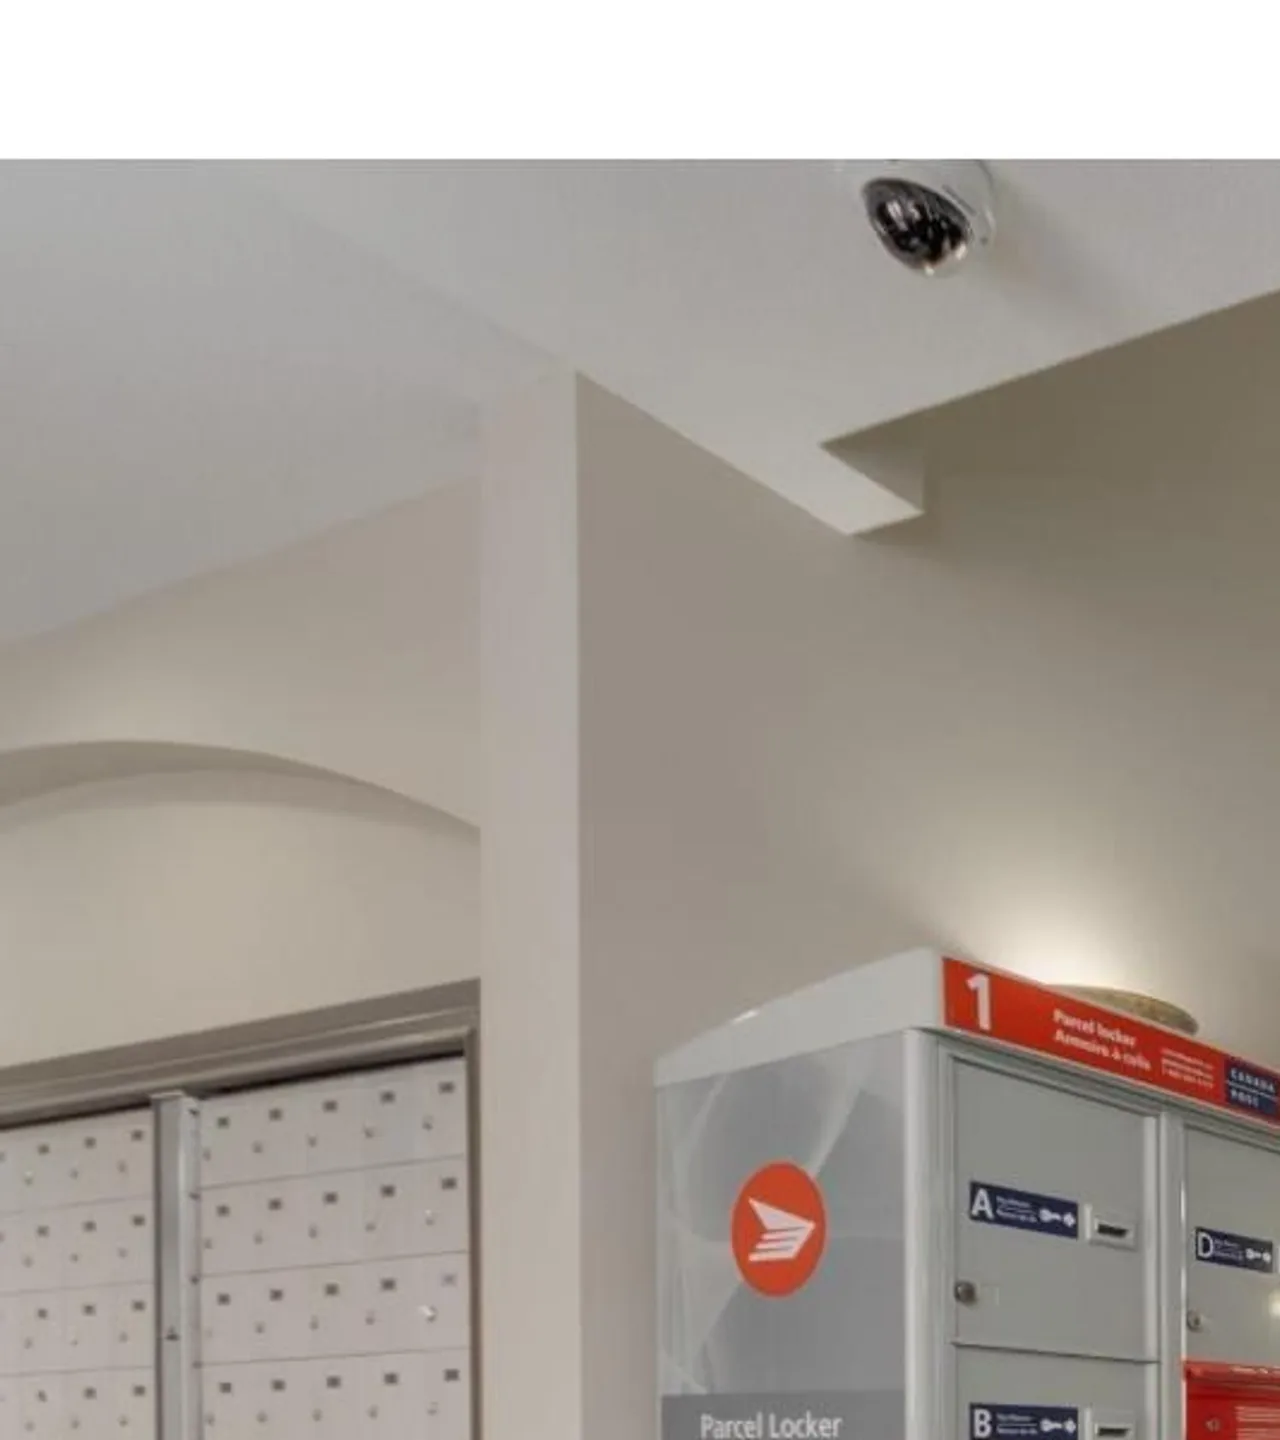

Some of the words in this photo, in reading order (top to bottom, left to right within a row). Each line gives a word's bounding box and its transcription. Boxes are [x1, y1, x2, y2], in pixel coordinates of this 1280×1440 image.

[966, 972, 992, 1031] 1
[971, 1187, 995, 1220] A
[1198, 1231, 1214, 1259] D
[700, 1412, 762, 1440] Parcel
[768, 1410, 842, 1440] Locker
[974, 1408, 992, 1439] B
